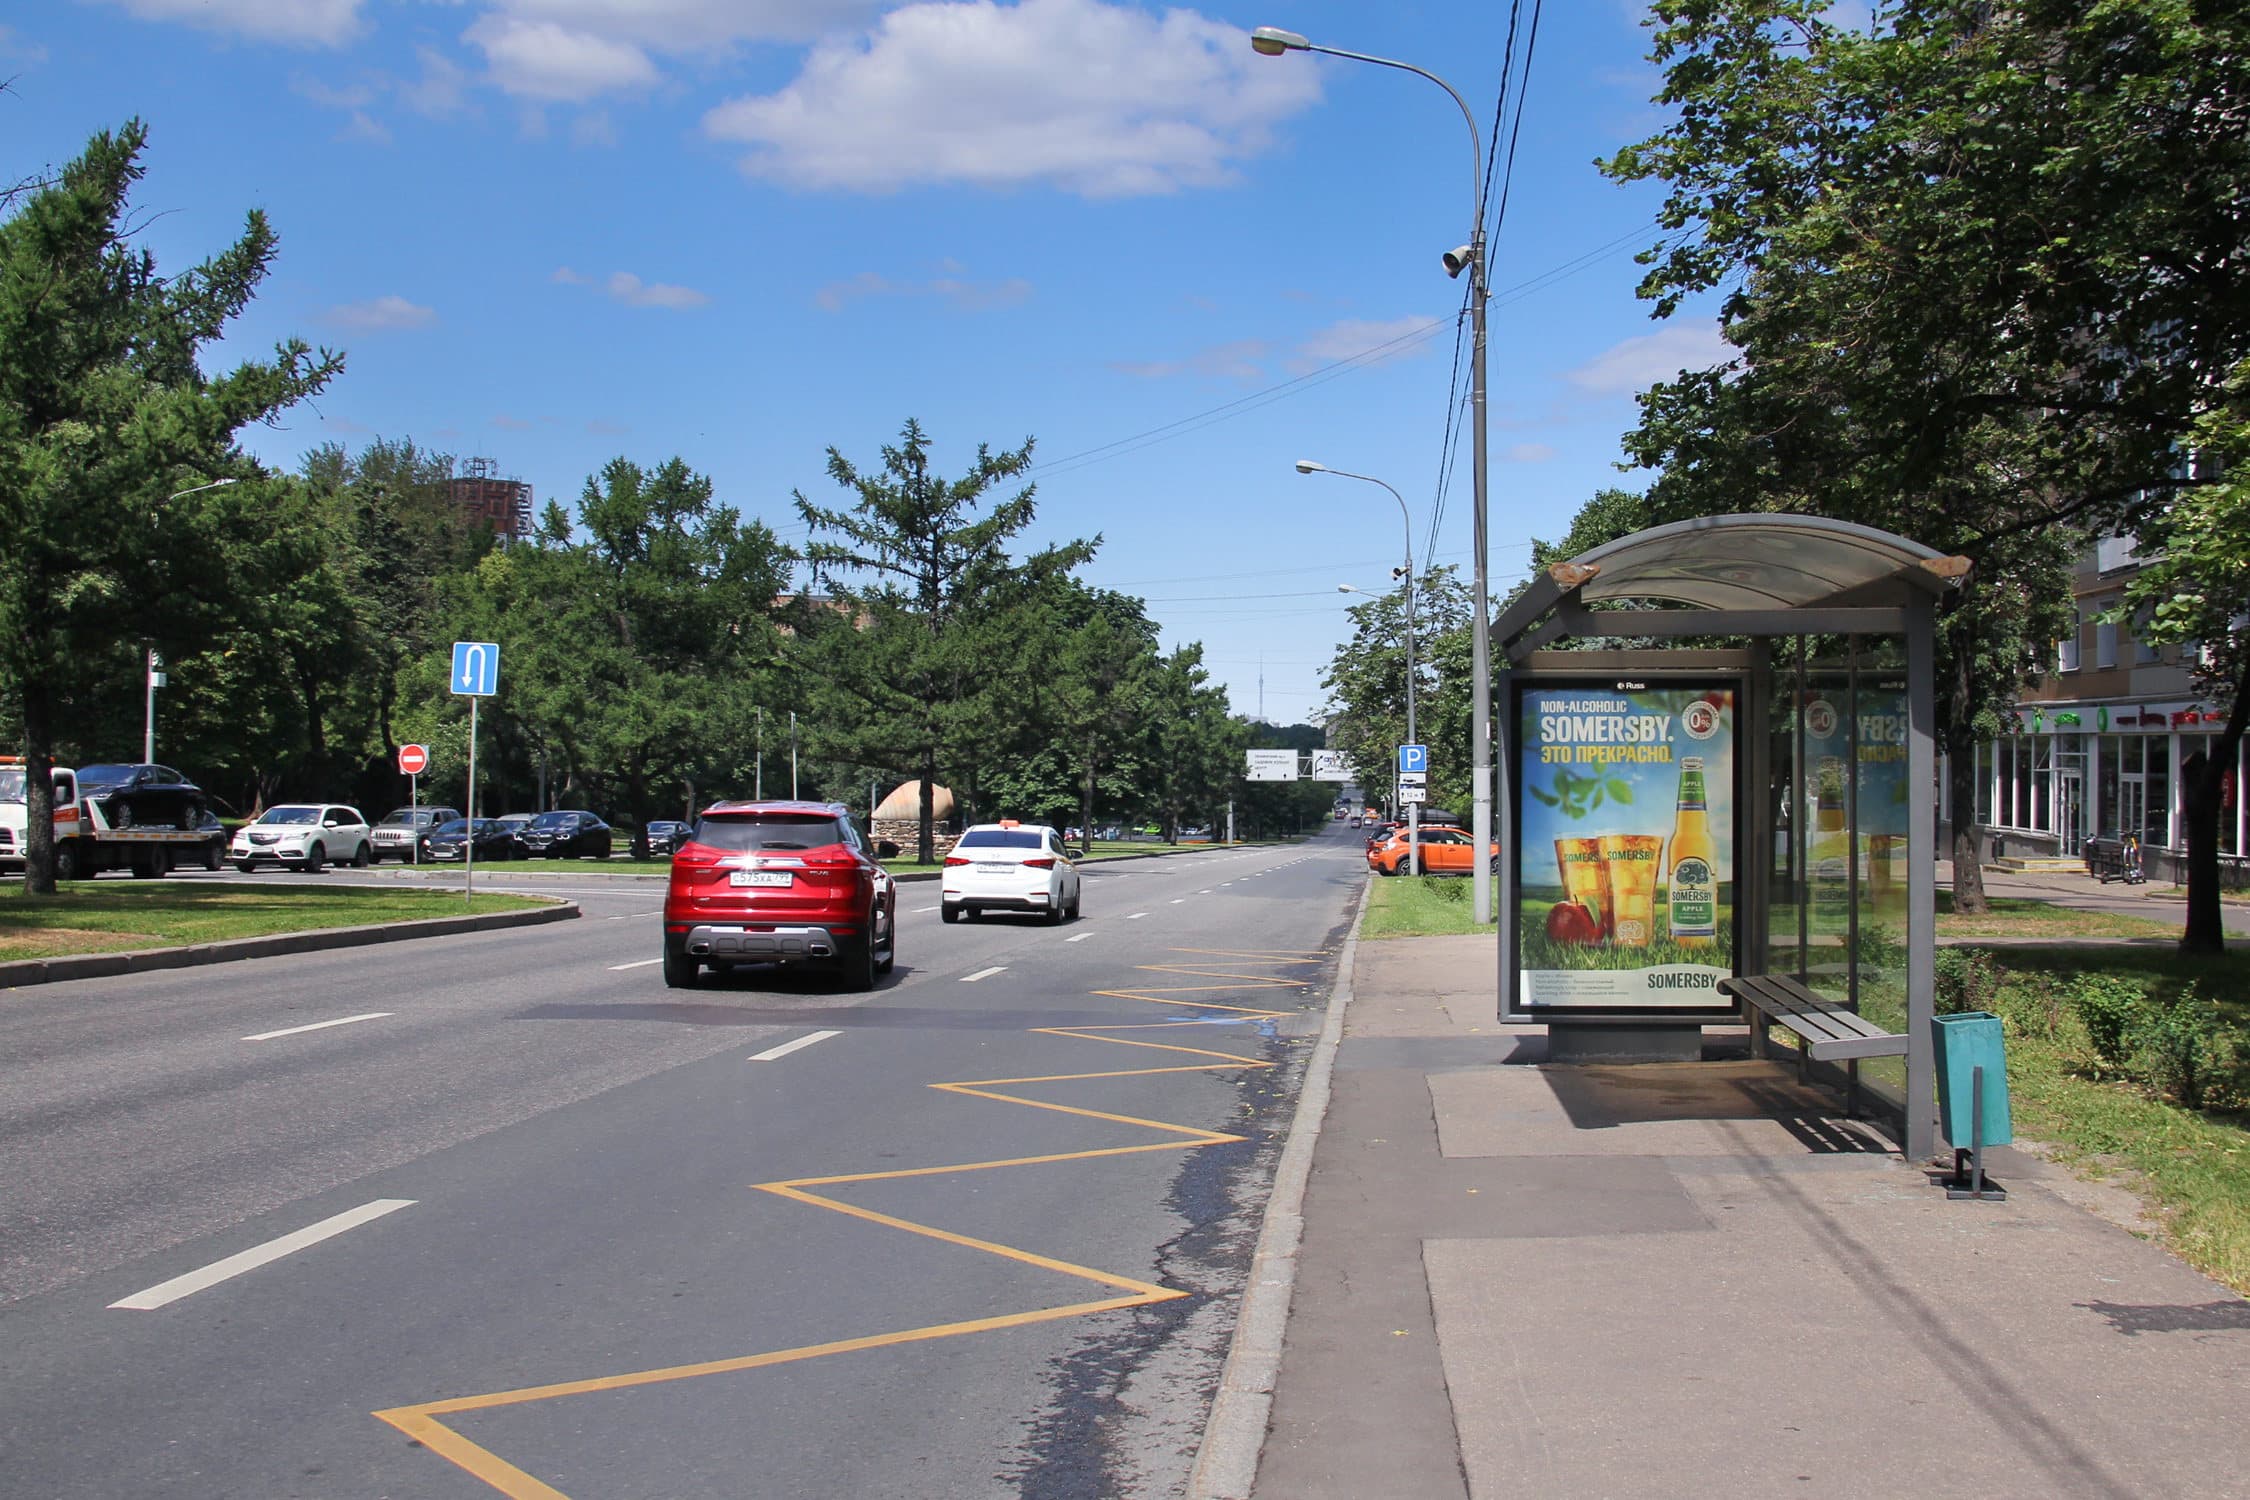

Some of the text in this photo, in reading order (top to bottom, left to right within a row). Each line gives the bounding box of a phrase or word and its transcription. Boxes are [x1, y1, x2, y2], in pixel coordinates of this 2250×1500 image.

[1626, 682, 1645, 690] Russ
[1541, 700, 1627, 713] NON-ALCOHOLIC
[1541, 716, 1675, 742] SOMERSBY.
[1407, 748, 1421, 769] P
[1541, 745, 1673, 763] ЭТО ПРЕКРАСНО.
[1607, 848, 1656, 861] SOMERSBY
[1672, 891, 1712, 901] SOMERSBY
[1648, 973, 1717, 989] SOMERSBY
